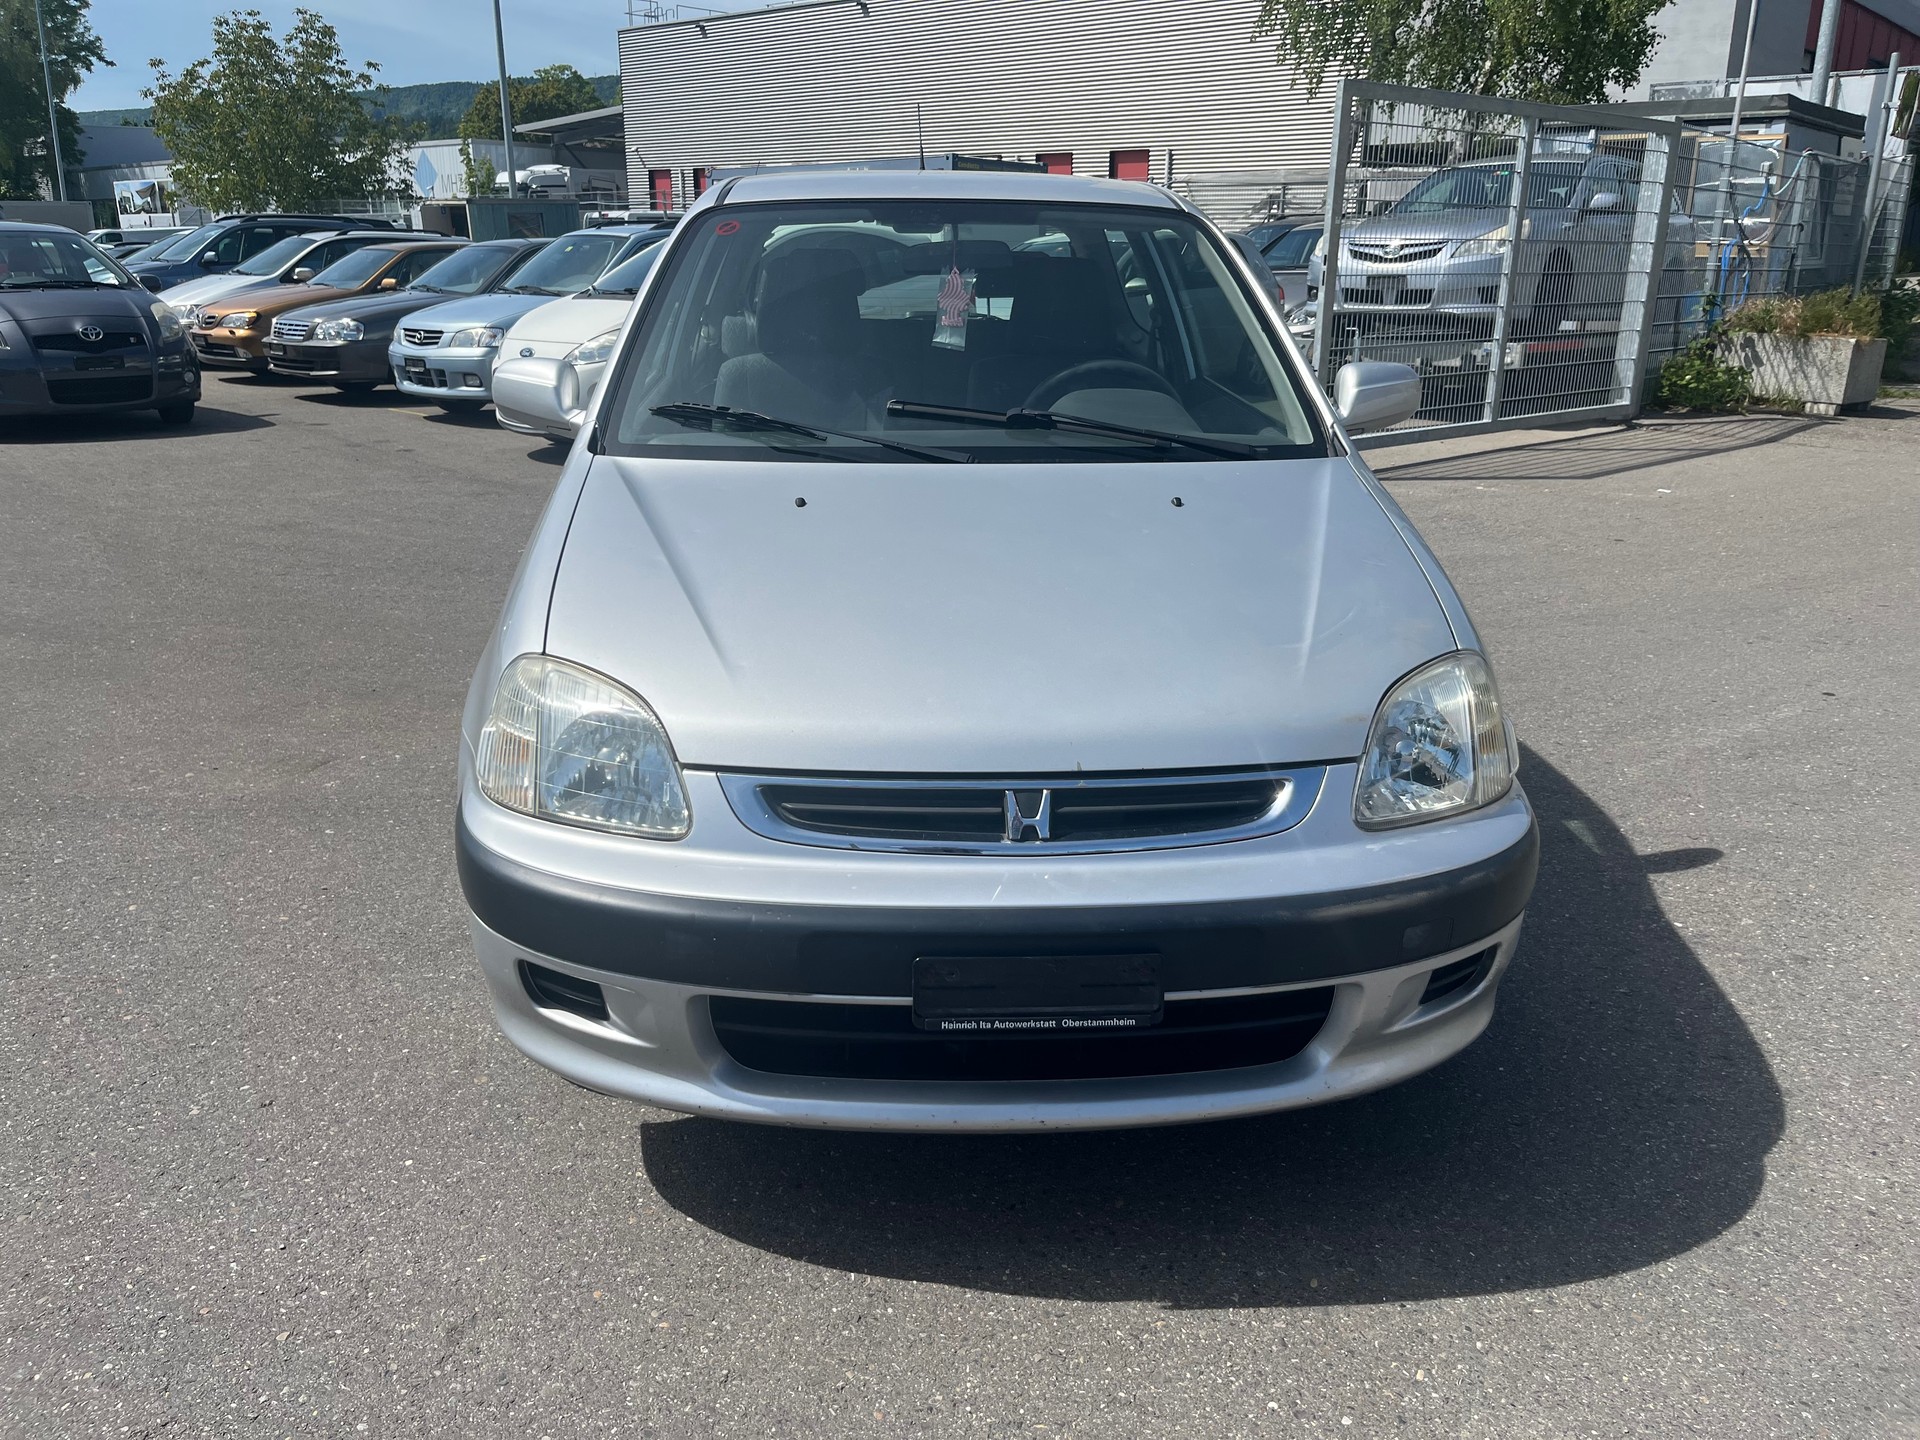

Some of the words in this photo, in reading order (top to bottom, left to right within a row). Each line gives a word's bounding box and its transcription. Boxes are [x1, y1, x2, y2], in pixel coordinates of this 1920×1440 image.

[941, 1020, 978, 1030] Heinrich
[993, 1020, 1056, 1029] Autowerkstatt
[1062, 1018, 1136, 1027] Oberstammheim
